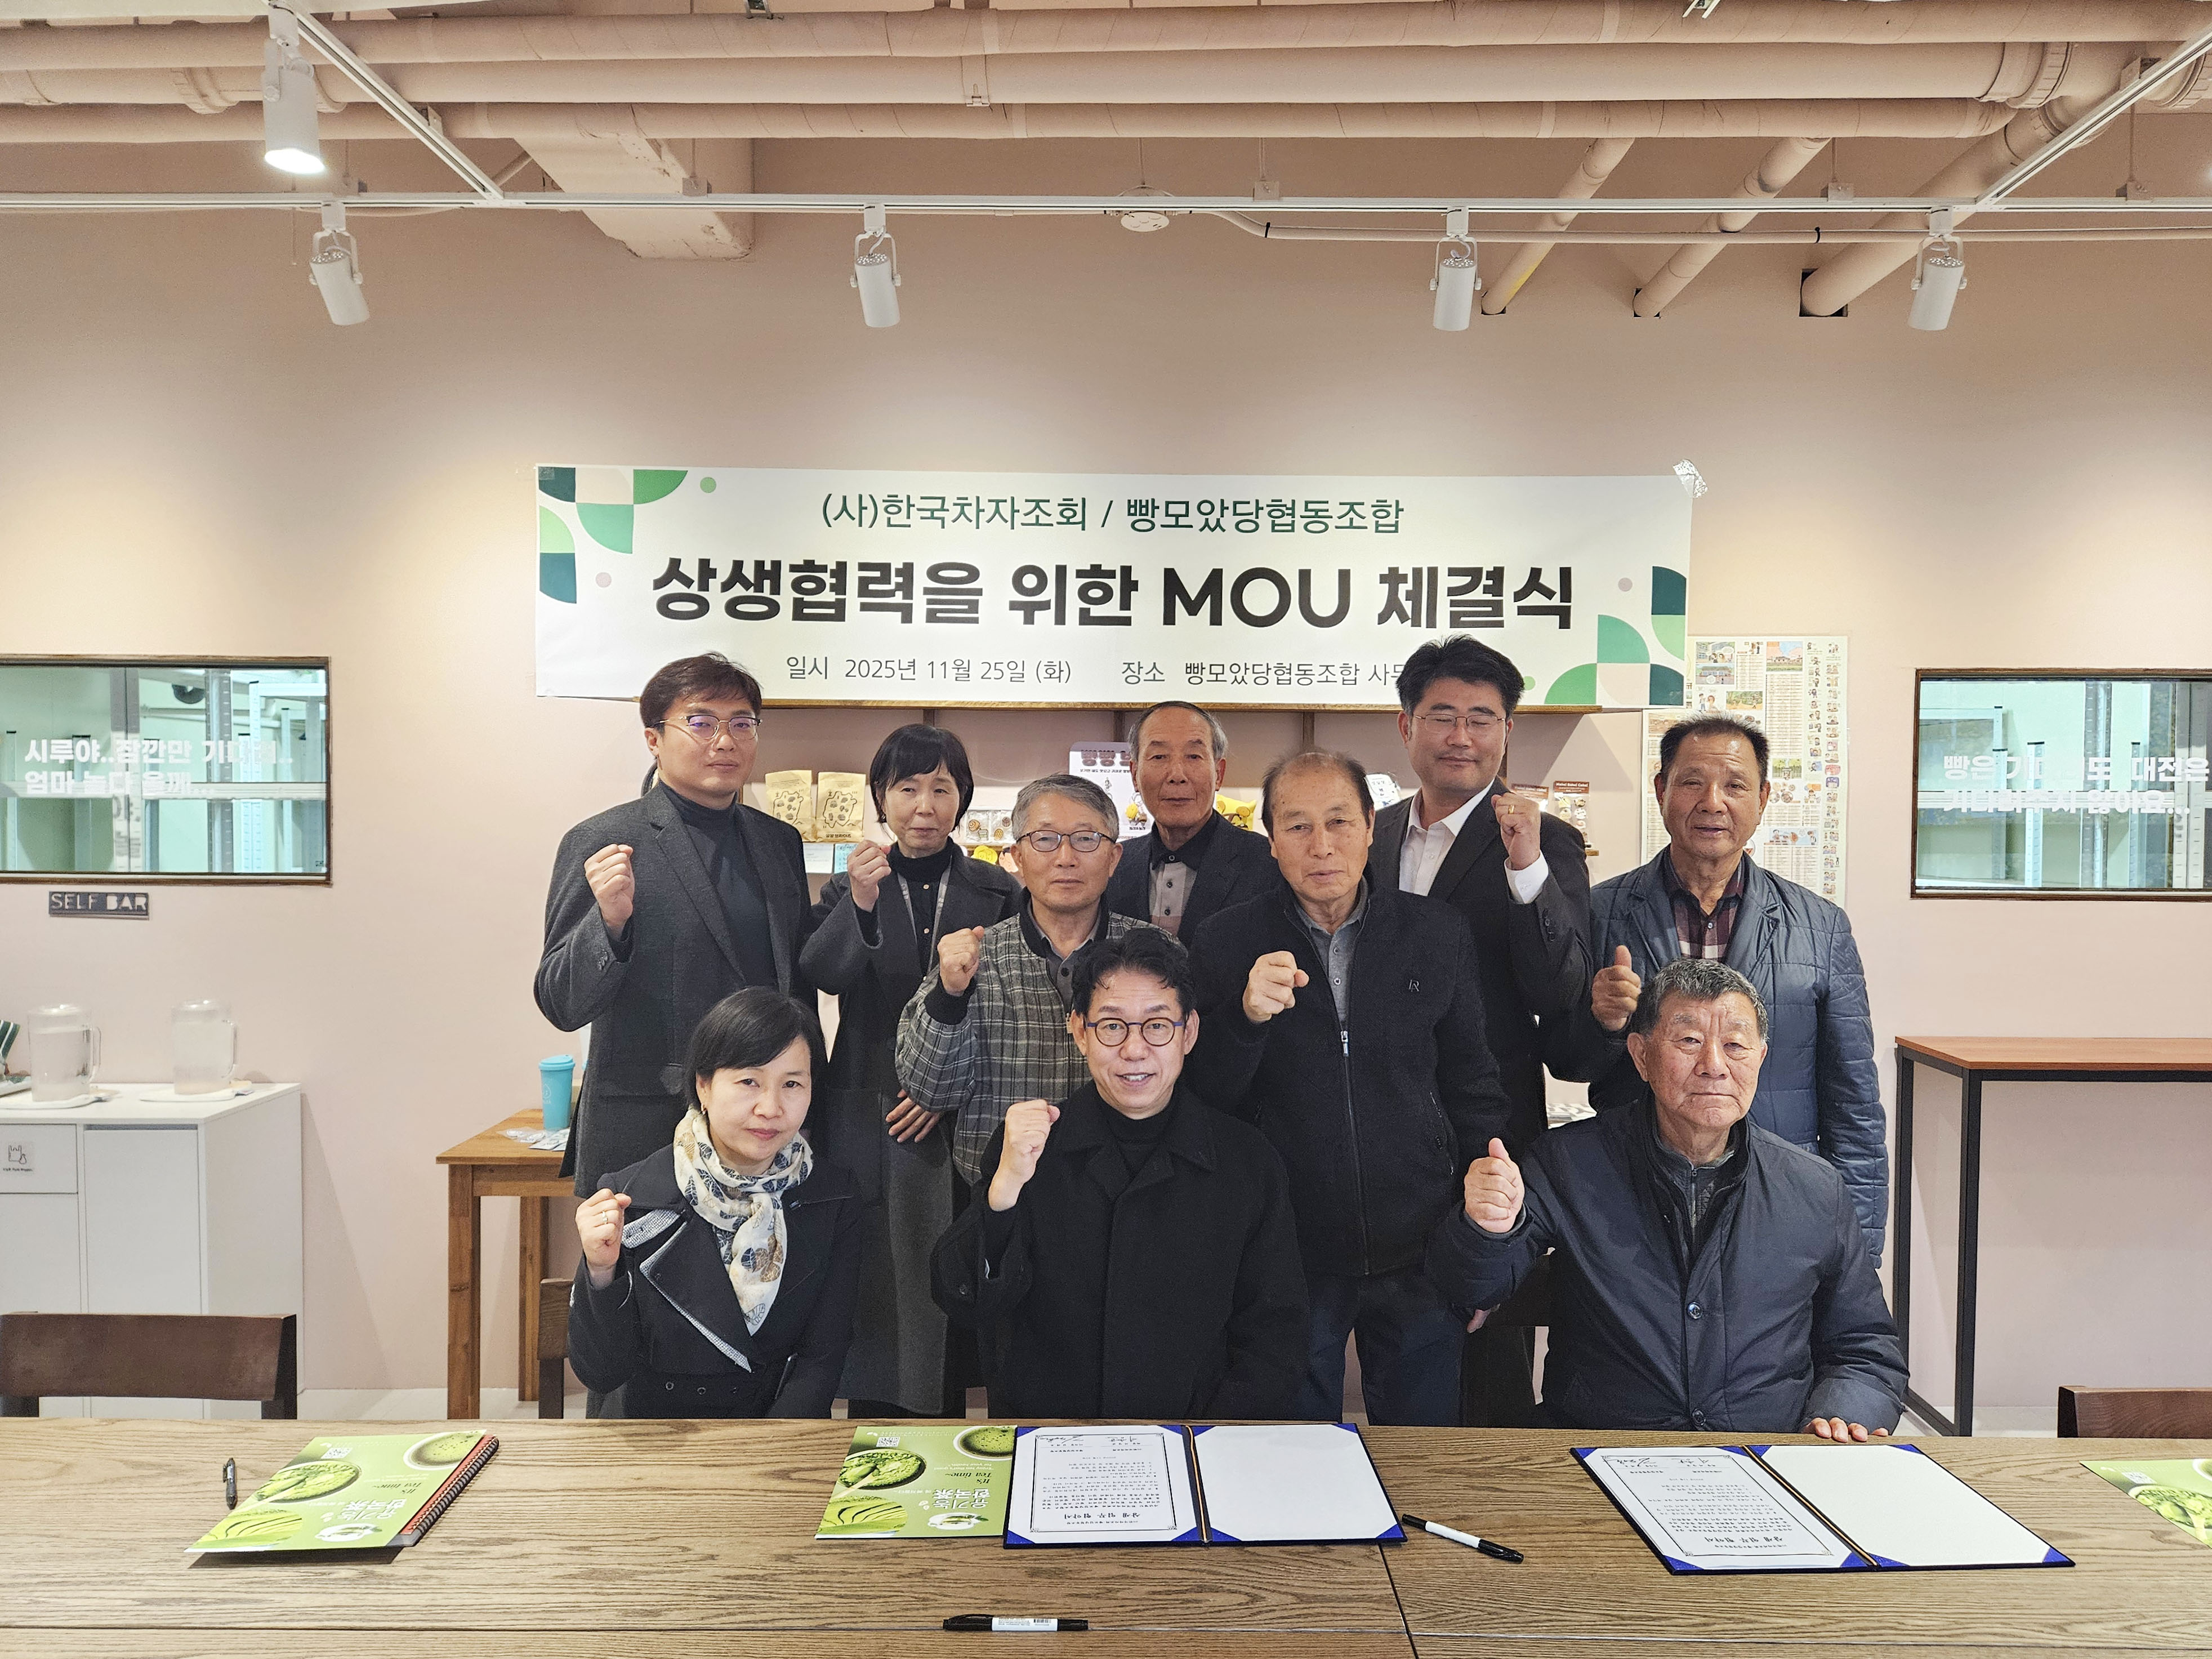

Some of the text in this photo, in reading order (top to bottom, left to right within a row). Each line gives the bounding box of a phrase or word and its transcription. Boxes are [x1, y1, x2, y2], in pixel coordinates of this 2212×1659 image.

[822, 493, 1405, 535] (사)한국차자조회 / 빵모았당협동조합
[653, 557, 1573, 630] 상생협력을 위한 MOU 체결식
[787, 656, 829, 681] 일시
[845, 658, 917, 681] 2025년
[928, 659, 971, 683] 11월
[981, 661, 1026, 684] 25일
[1036, 661, 1072, 684] (화)
[1122, 661, 1166, 686] 장소
[1185, 661, 1361, 687] 빵모았당협동조합
[2131, 756, 2210, 782] 대전은
[51, 893, 148, 911] SELF BAR
[932, 1499, 989, 1510] 유기농
